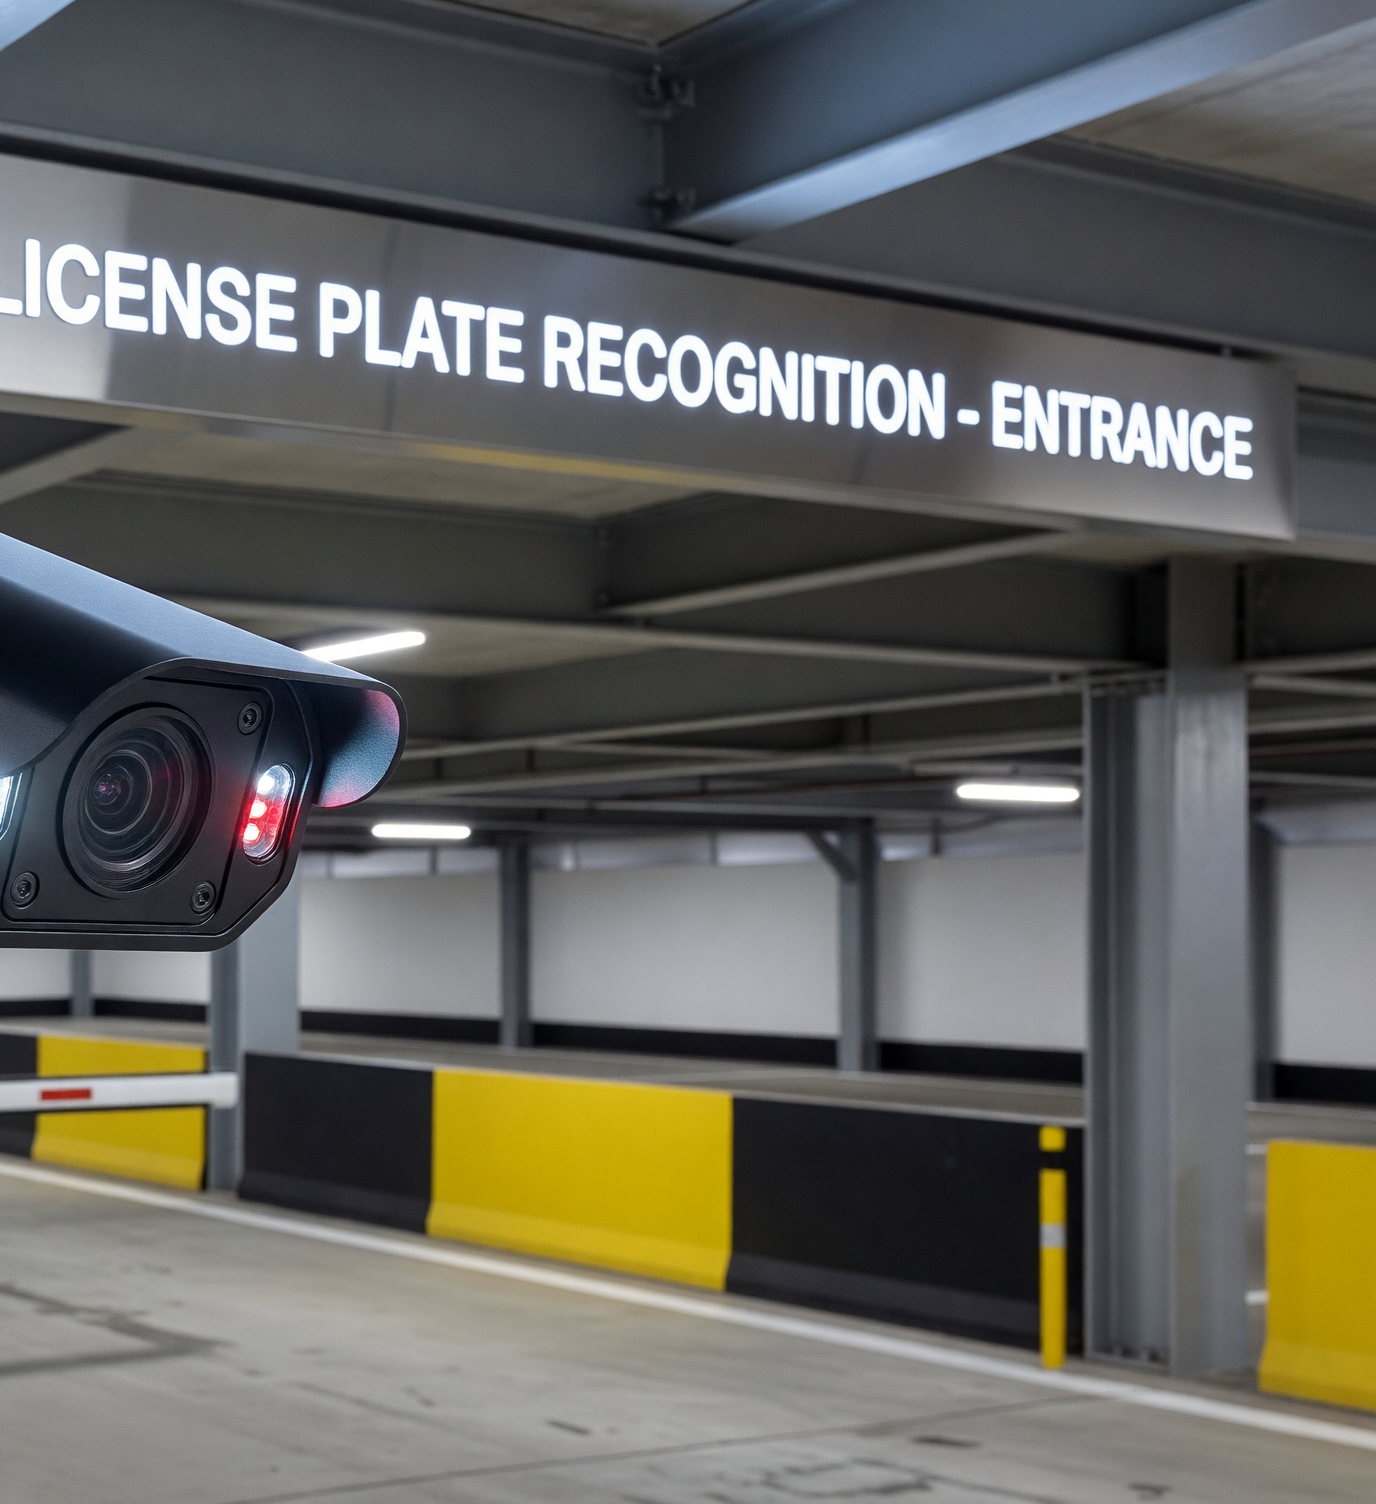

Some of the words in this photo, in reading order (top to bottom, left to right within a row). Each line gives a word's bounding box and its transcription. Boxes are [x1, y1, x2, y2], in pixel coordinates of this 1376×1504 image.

[319, 281, 525, 384] PLATE
[543, 315, 946, 440] RECOGNITION
[957, 409, 980, 425] -
[992, 380, 1254, 480] ENTRANCE
